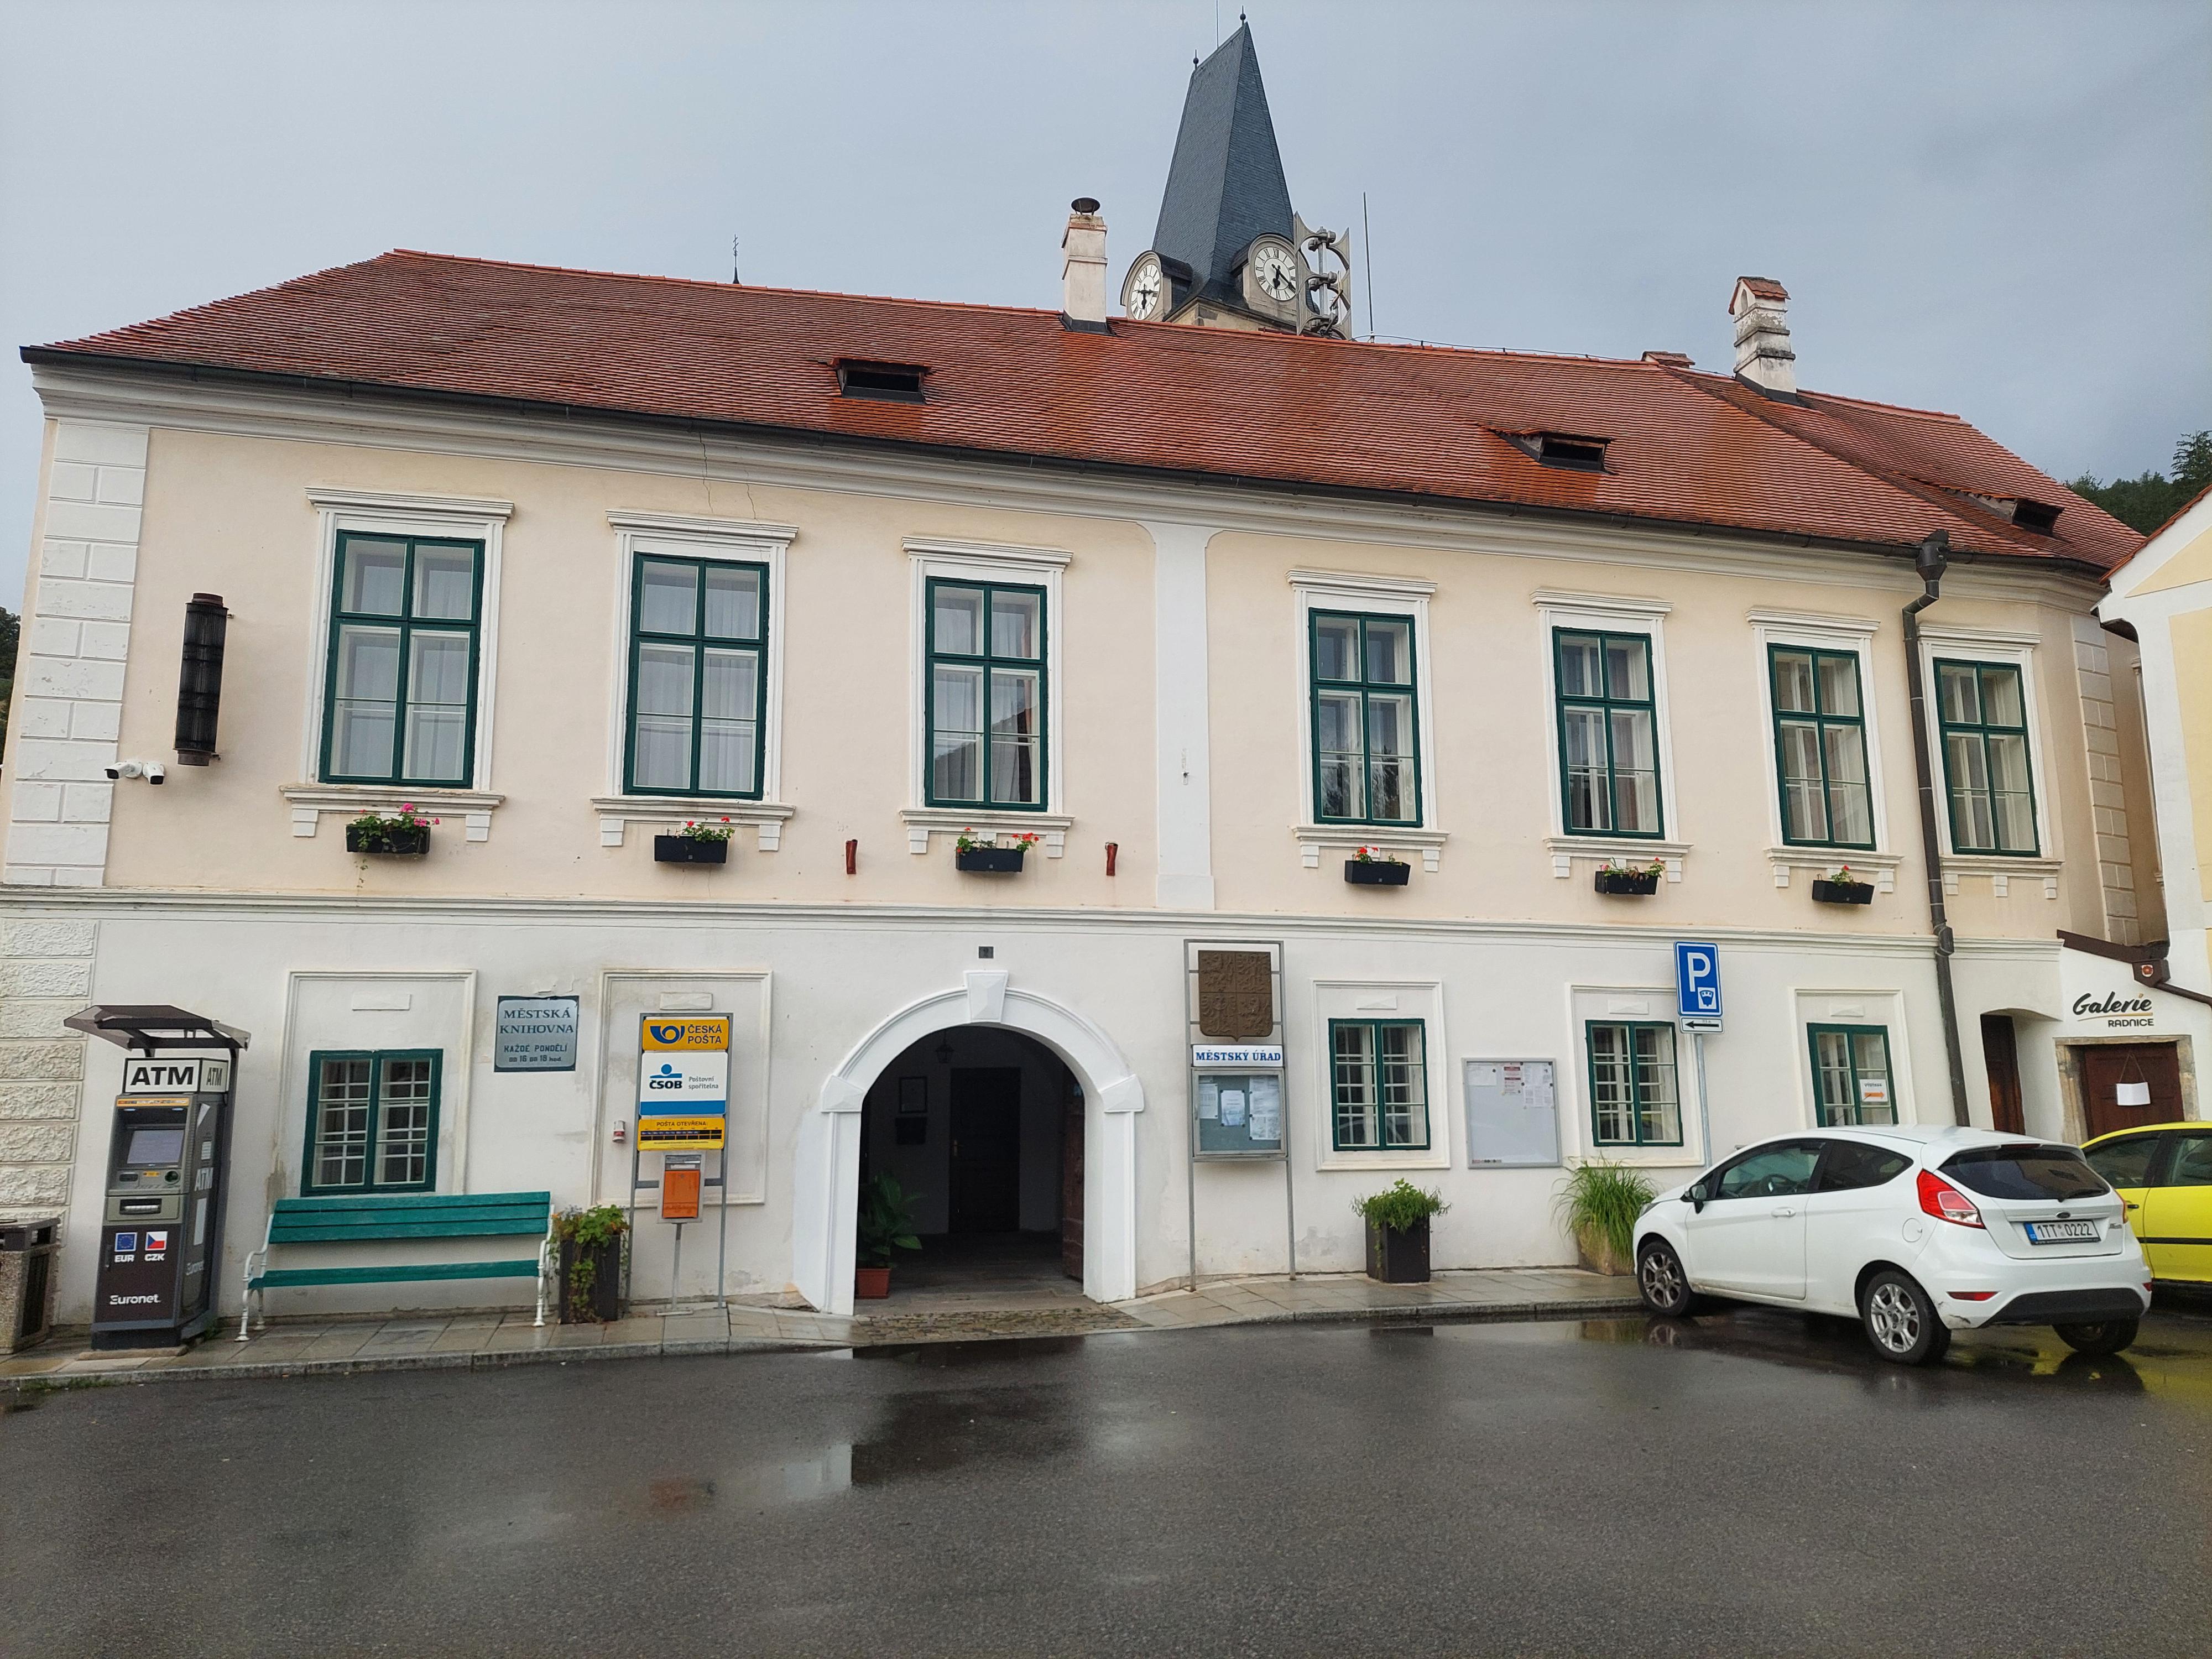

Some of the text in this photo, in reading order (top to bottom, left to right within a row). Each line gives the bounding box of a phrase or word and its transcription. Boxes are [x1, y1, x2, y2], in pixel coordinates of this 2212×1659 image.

[1687, 952, 1711, 992] P
[2073, 991, 2152, 1015] Galerie
[504, 1007, 571, 1019] MĚSTSKÁ
[2107, 1019, 2154, 1027] RADNICE
[500, 1025, 573, 1034] KNIHOVNA
[687, 1024, 722, 1034] ČESKÁ
[687, 1034, 722, 1044] POŠTA
[504, 1042, 568, 1052] KAŽDÉ PONDĚLÍ
[1196, 1050, 1281, 1061] MĚSTSKÝ ÚŘAD
[131, 1066, 194, 1086] ATM
[206, 1067, 223, 1086] ATM
[649, 1079, 682, 1089] ČSOB
[195, 1167, 213, 1191] ATM
[2037, 1223, 2093, 1239] 1TT 0222
[114, 1254, 134, 1262] EUR
[144, 1253, 165, 1261] CZK
